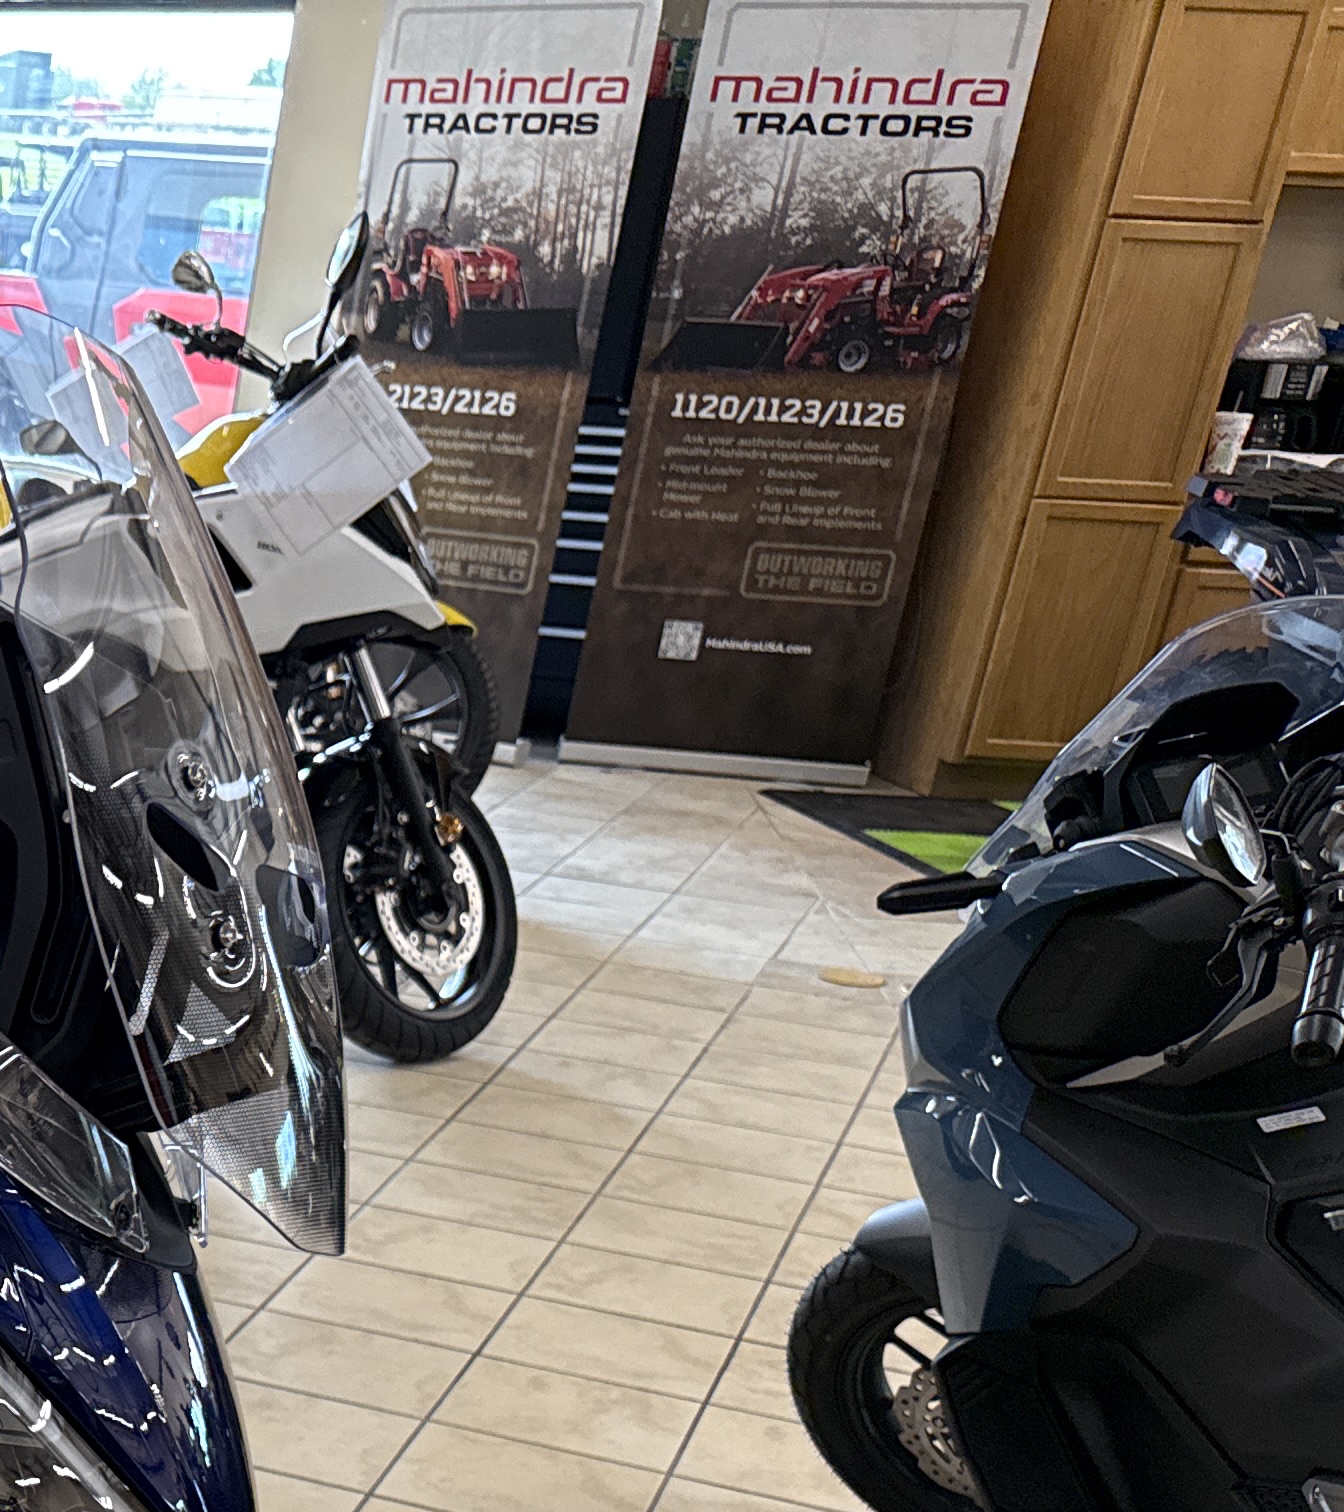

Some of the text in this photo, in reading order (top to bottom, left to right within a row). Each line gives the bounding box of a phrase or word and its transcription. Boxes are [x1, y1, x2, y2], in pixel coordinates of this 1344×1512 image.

[383, 67, 630, 105] mahindra
[709, 67, 1010, 106] mahindra
[404, 112, 599, 135] TRACTORS
[733, 111, 974, 138] TRACTORS
[388, 383, 518, 416] 2123/2126
[670, 392, 907, 429] 1120/1123/1126
[844, 442, 880, 454] about
[756, 553, 883, 580] OUTWORKING
[754, 574, 877, 595] THE FIELD
